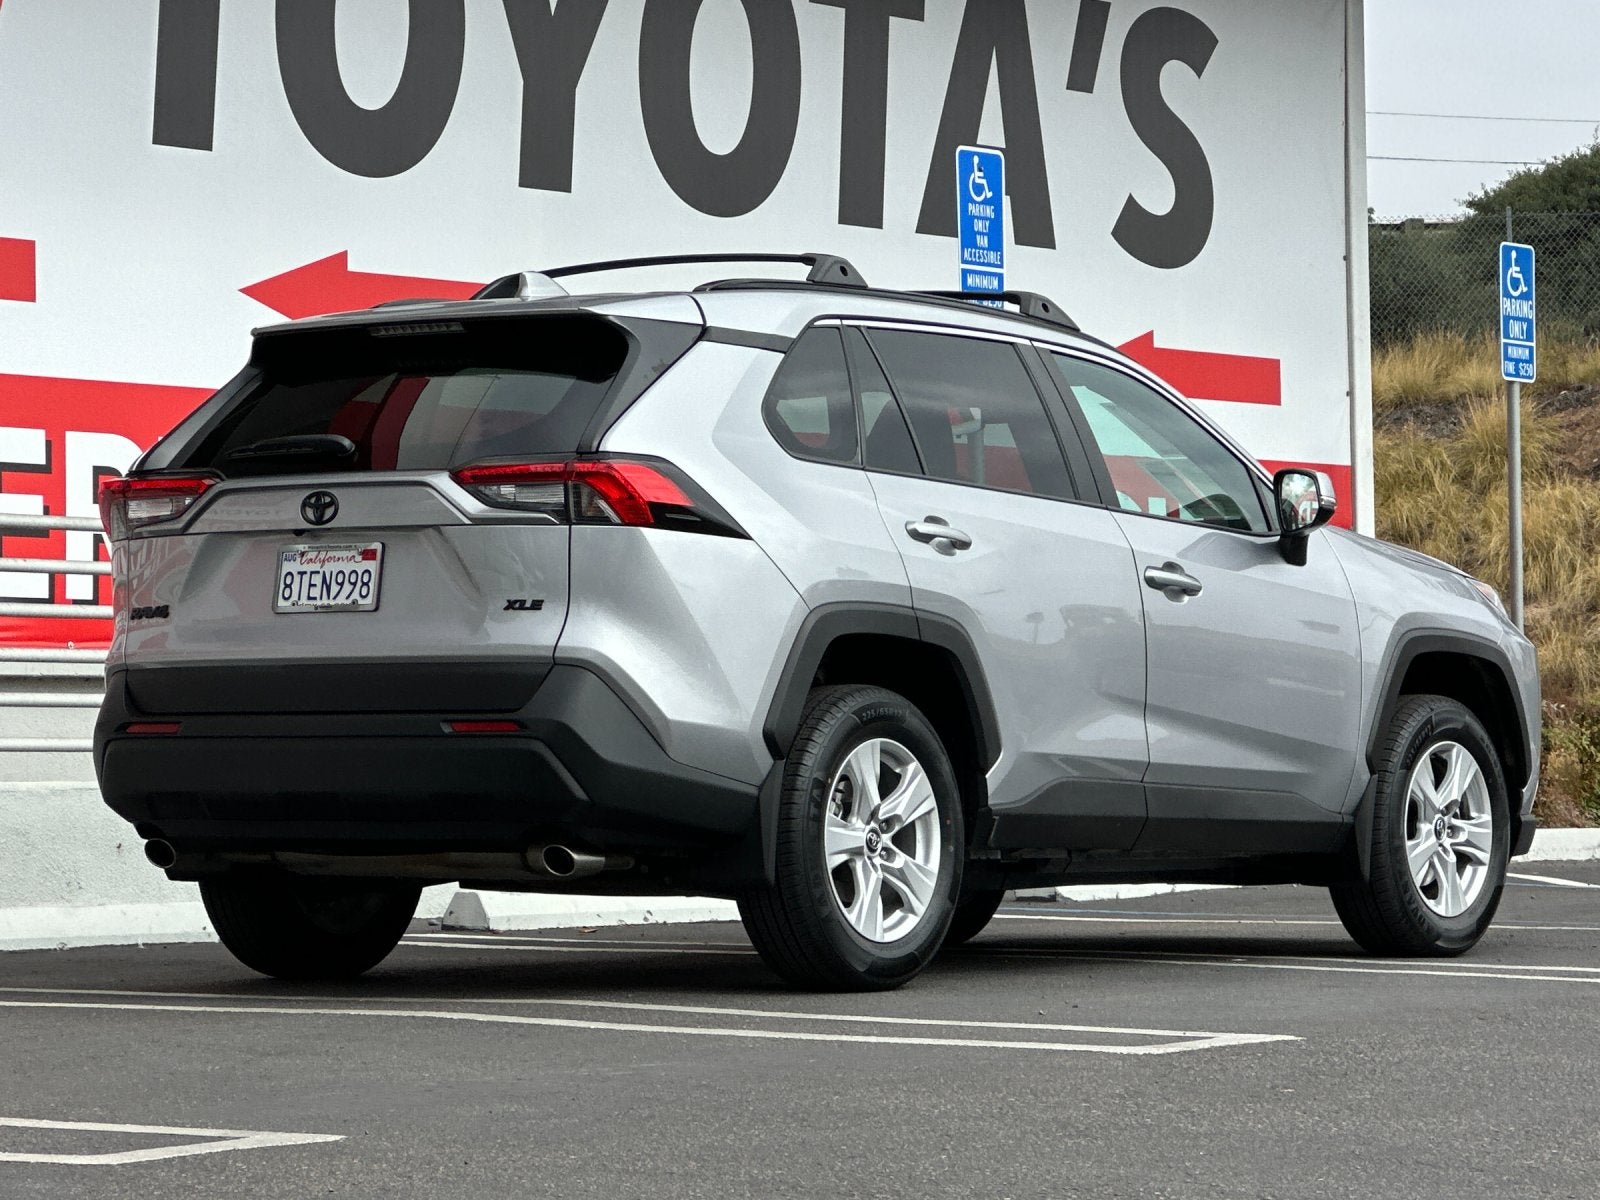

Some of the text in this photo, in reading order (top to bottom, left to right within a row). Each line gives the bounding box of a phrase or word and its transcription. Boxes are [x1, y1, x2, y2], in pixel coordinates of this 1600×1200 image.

[968, 202, 995, 219] PARKING
[973, 219, 990, 233] ONLY
[976, 234, 988, 248] VAN
[963, 249, 1001, 265] ACCESSIBLE
[966, 273, 999, 290] MINIMUM
[1503, 297, 1533, 319] PARKING
[1509, 319, 1528, 339] ONLY
[1507, 345, 1530, 360] MINIMUM
[1504, 360, 1533, 377] FINE $250
[283, 550, 362, 569] AUG California
[282, 569, 372, 601] 8TEN998
[503, 599, 545, 611] XLE
